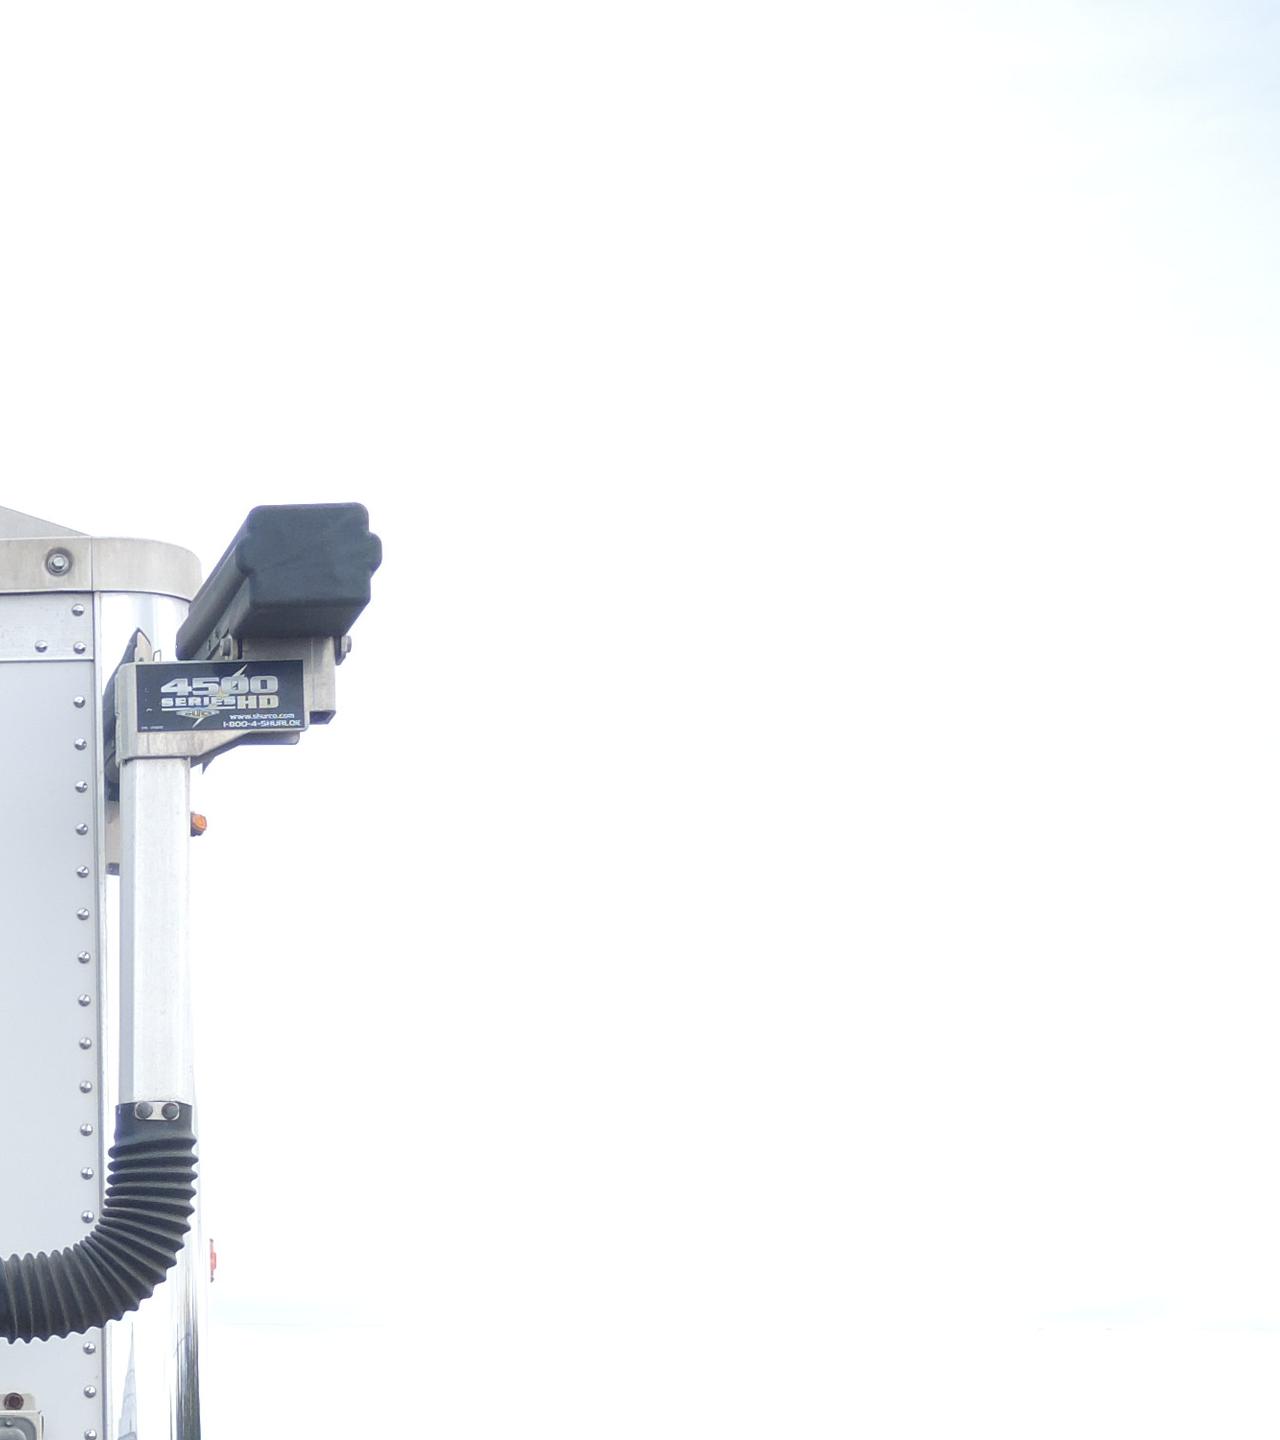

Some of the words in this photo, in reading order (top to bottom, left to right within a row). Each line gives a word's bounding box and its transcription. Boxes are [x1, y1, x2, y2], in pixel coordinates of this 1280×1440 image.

[160, 675, 278, 696] 4500
[161, 696, 236, 707] SERIES
[237, 695, 280, 709] HD
